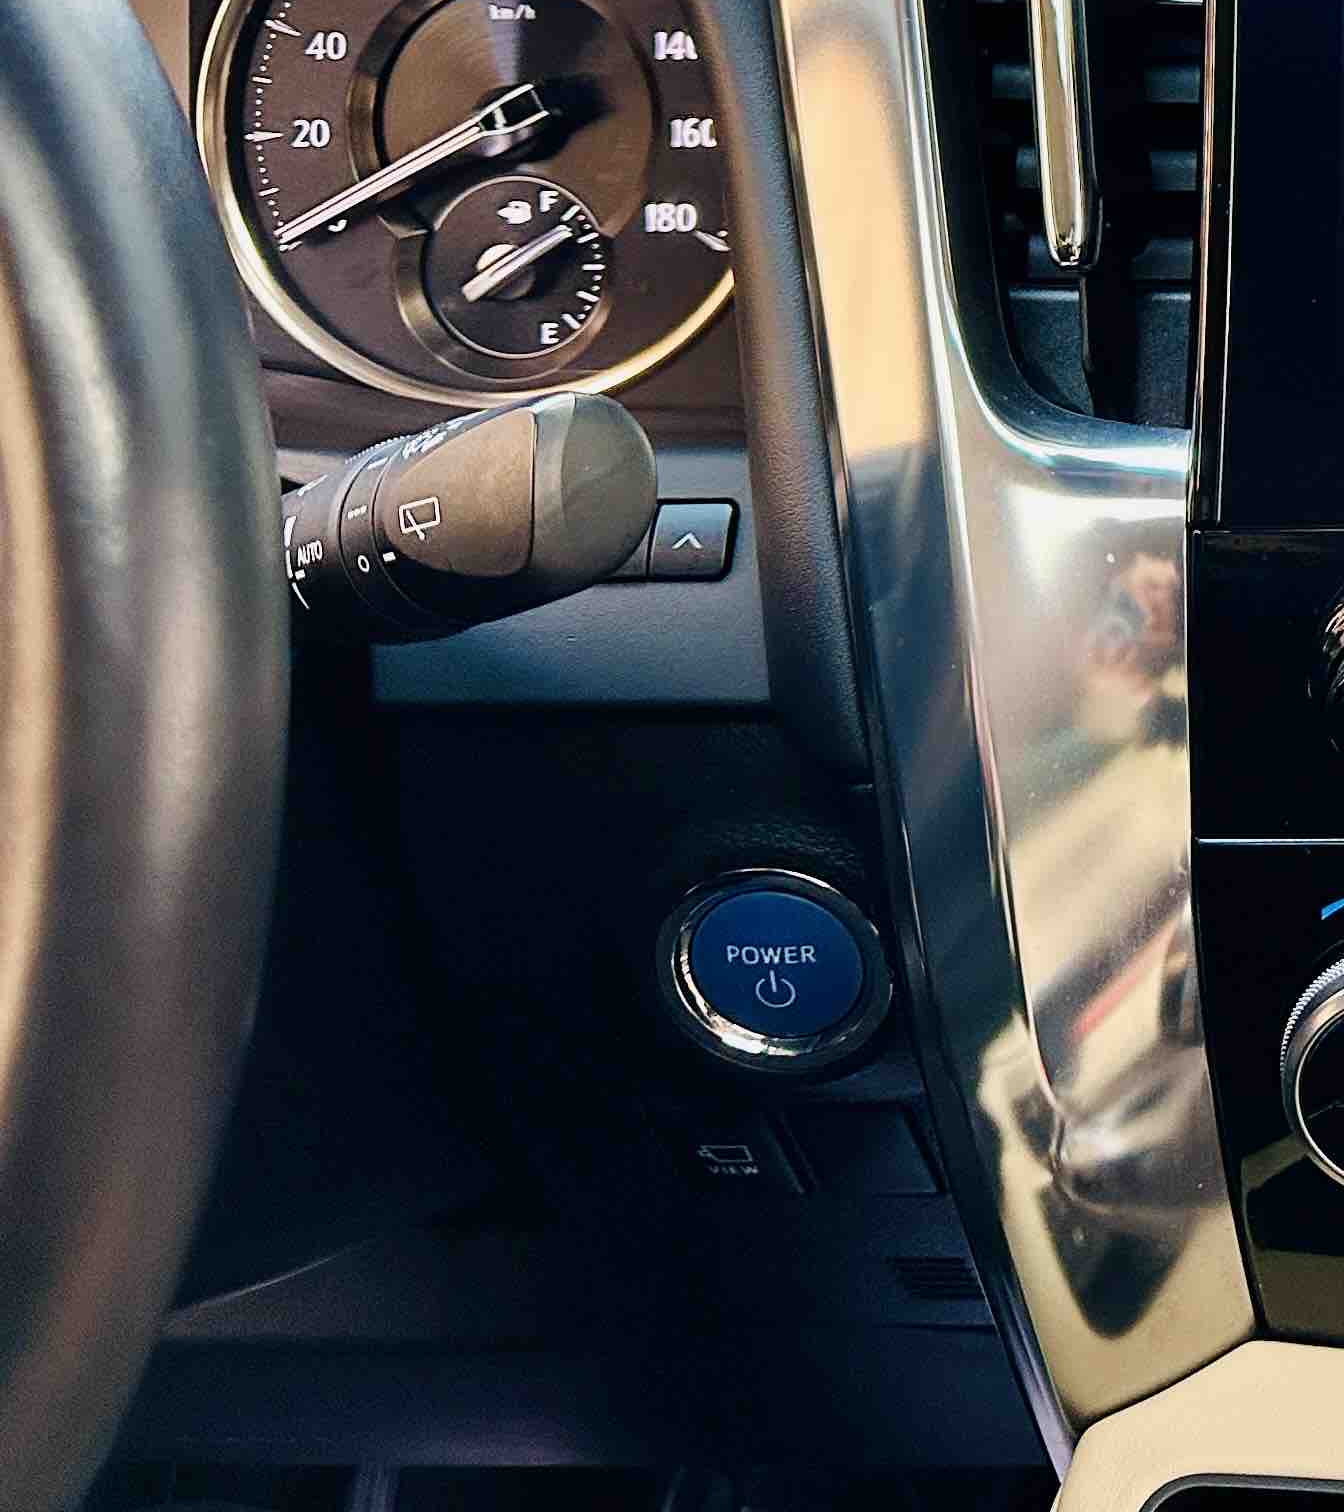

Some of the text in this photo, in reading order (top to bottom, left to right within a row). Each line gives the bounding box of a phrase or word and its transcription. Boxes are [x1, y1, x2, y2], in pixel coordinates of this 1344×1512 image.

[489, 4, 535, 19] km/h
[305, 32, 347, 60] 40
[291, 120, 330, 147] 20
[540, 191, 558, 212] F
[646, 203, 696, 232] 180
[540, 324, 558, 345] E
[297, 541, 323, 567] AUTO
[727, 945, 816, 965] POWER
